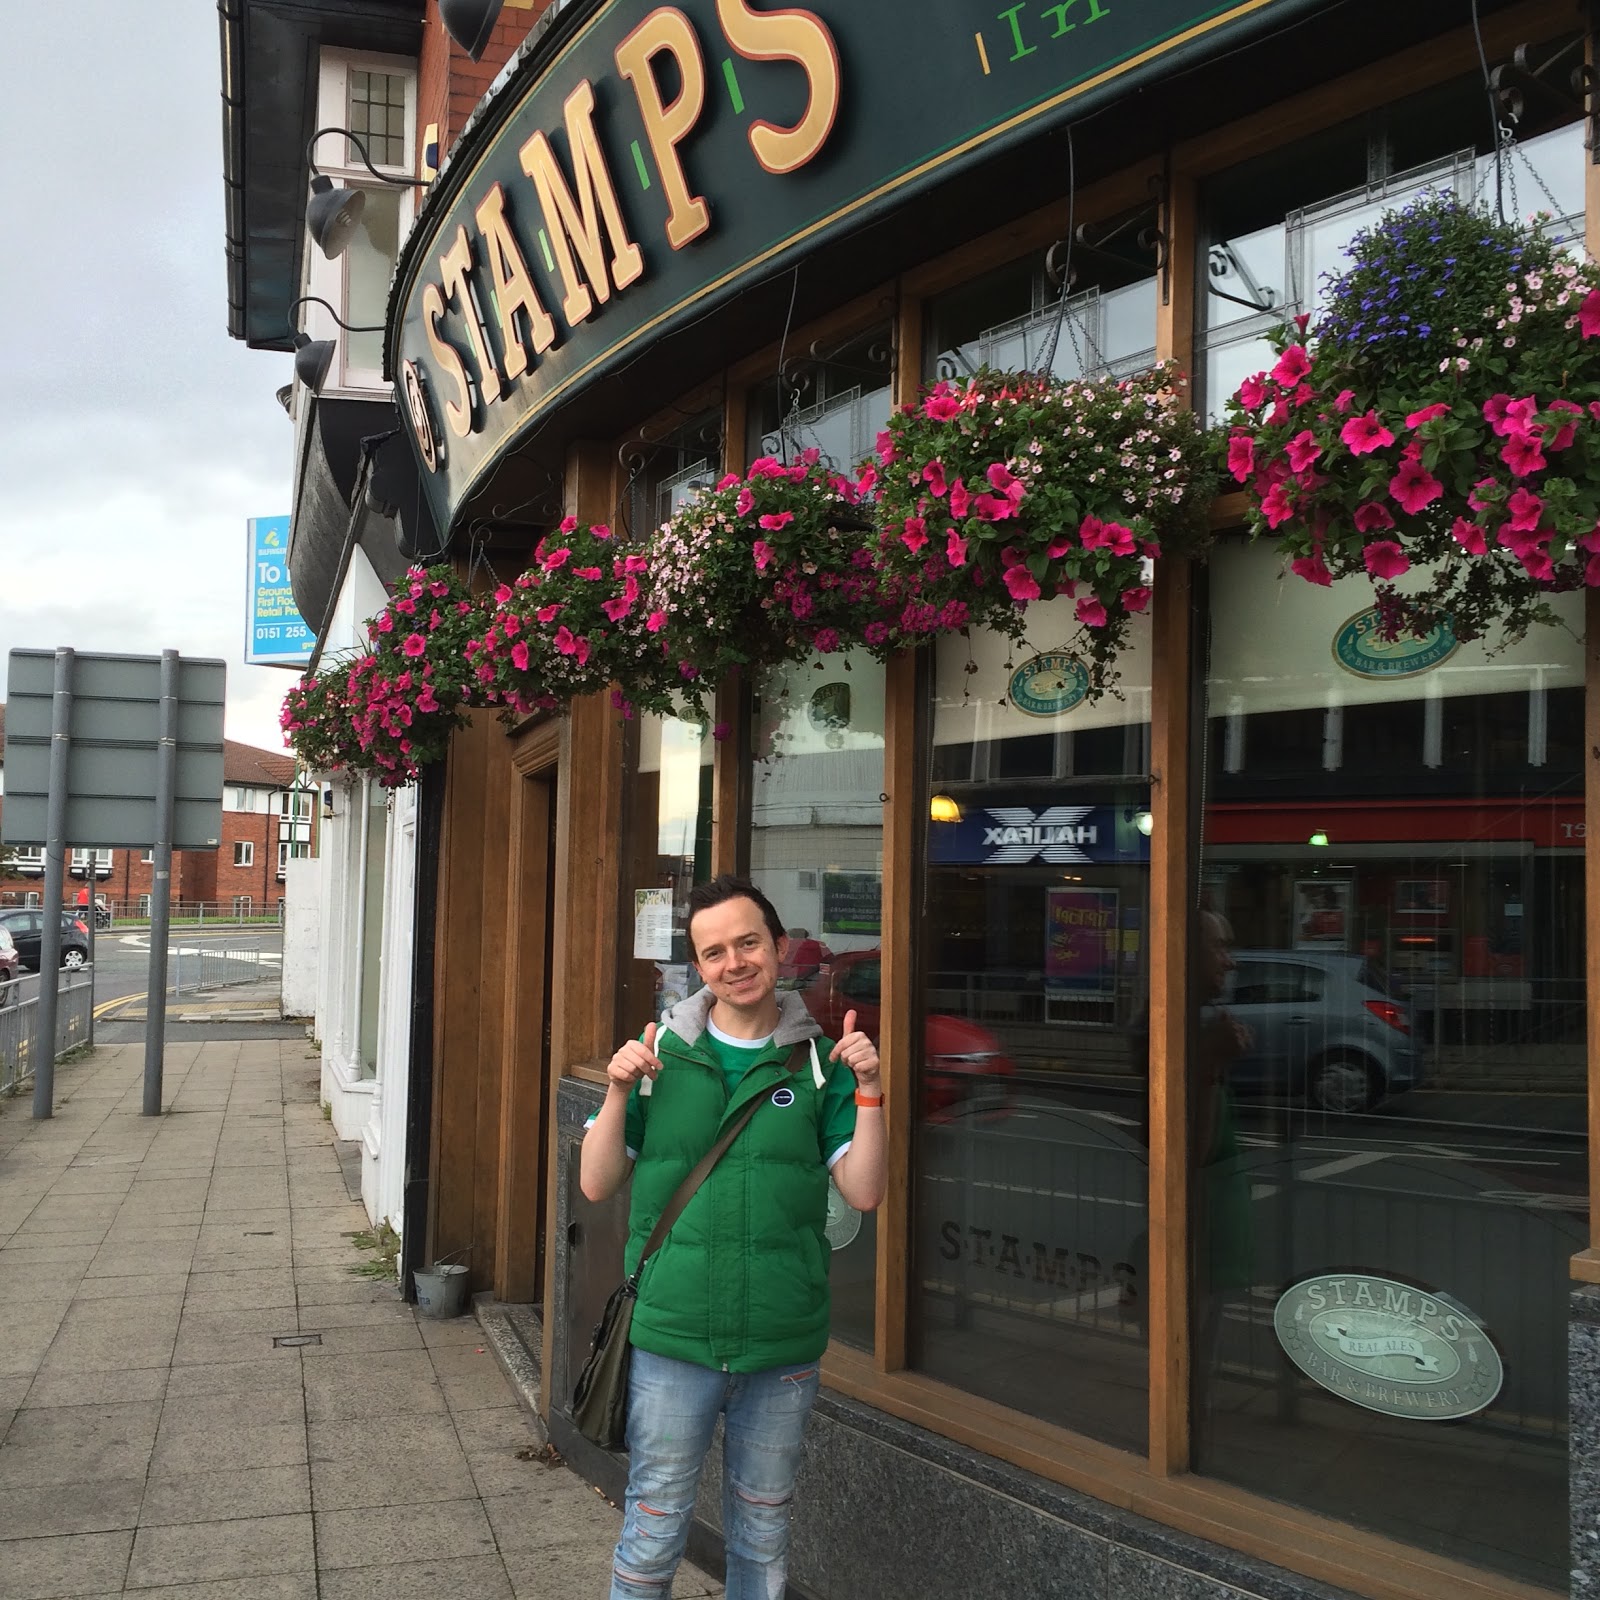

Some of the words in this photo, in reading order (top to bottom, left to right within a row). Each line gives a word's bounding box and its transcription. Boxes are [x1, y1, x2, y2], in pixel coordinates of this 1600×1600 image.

[258, 562, 281, 583] To
[257, 597, 274, 607] First
[258, 608, 282, 617] Retail
[256, 627, 280, 640] 0151
[285, 626, 307, 639] 255
[1355, 658, 1375, 671] BAR
[1388, 648, 1441, 671] BREWERY
[1348, 1341, 1380, 1353] REAL
[1384, 1340, 1415, 1352] ALES
[1305, 1351, 1342, 1385] BAR
[1345, 1376, 1360, 1394] &
[1365, 1382, 1464, 1409] BREWERY
